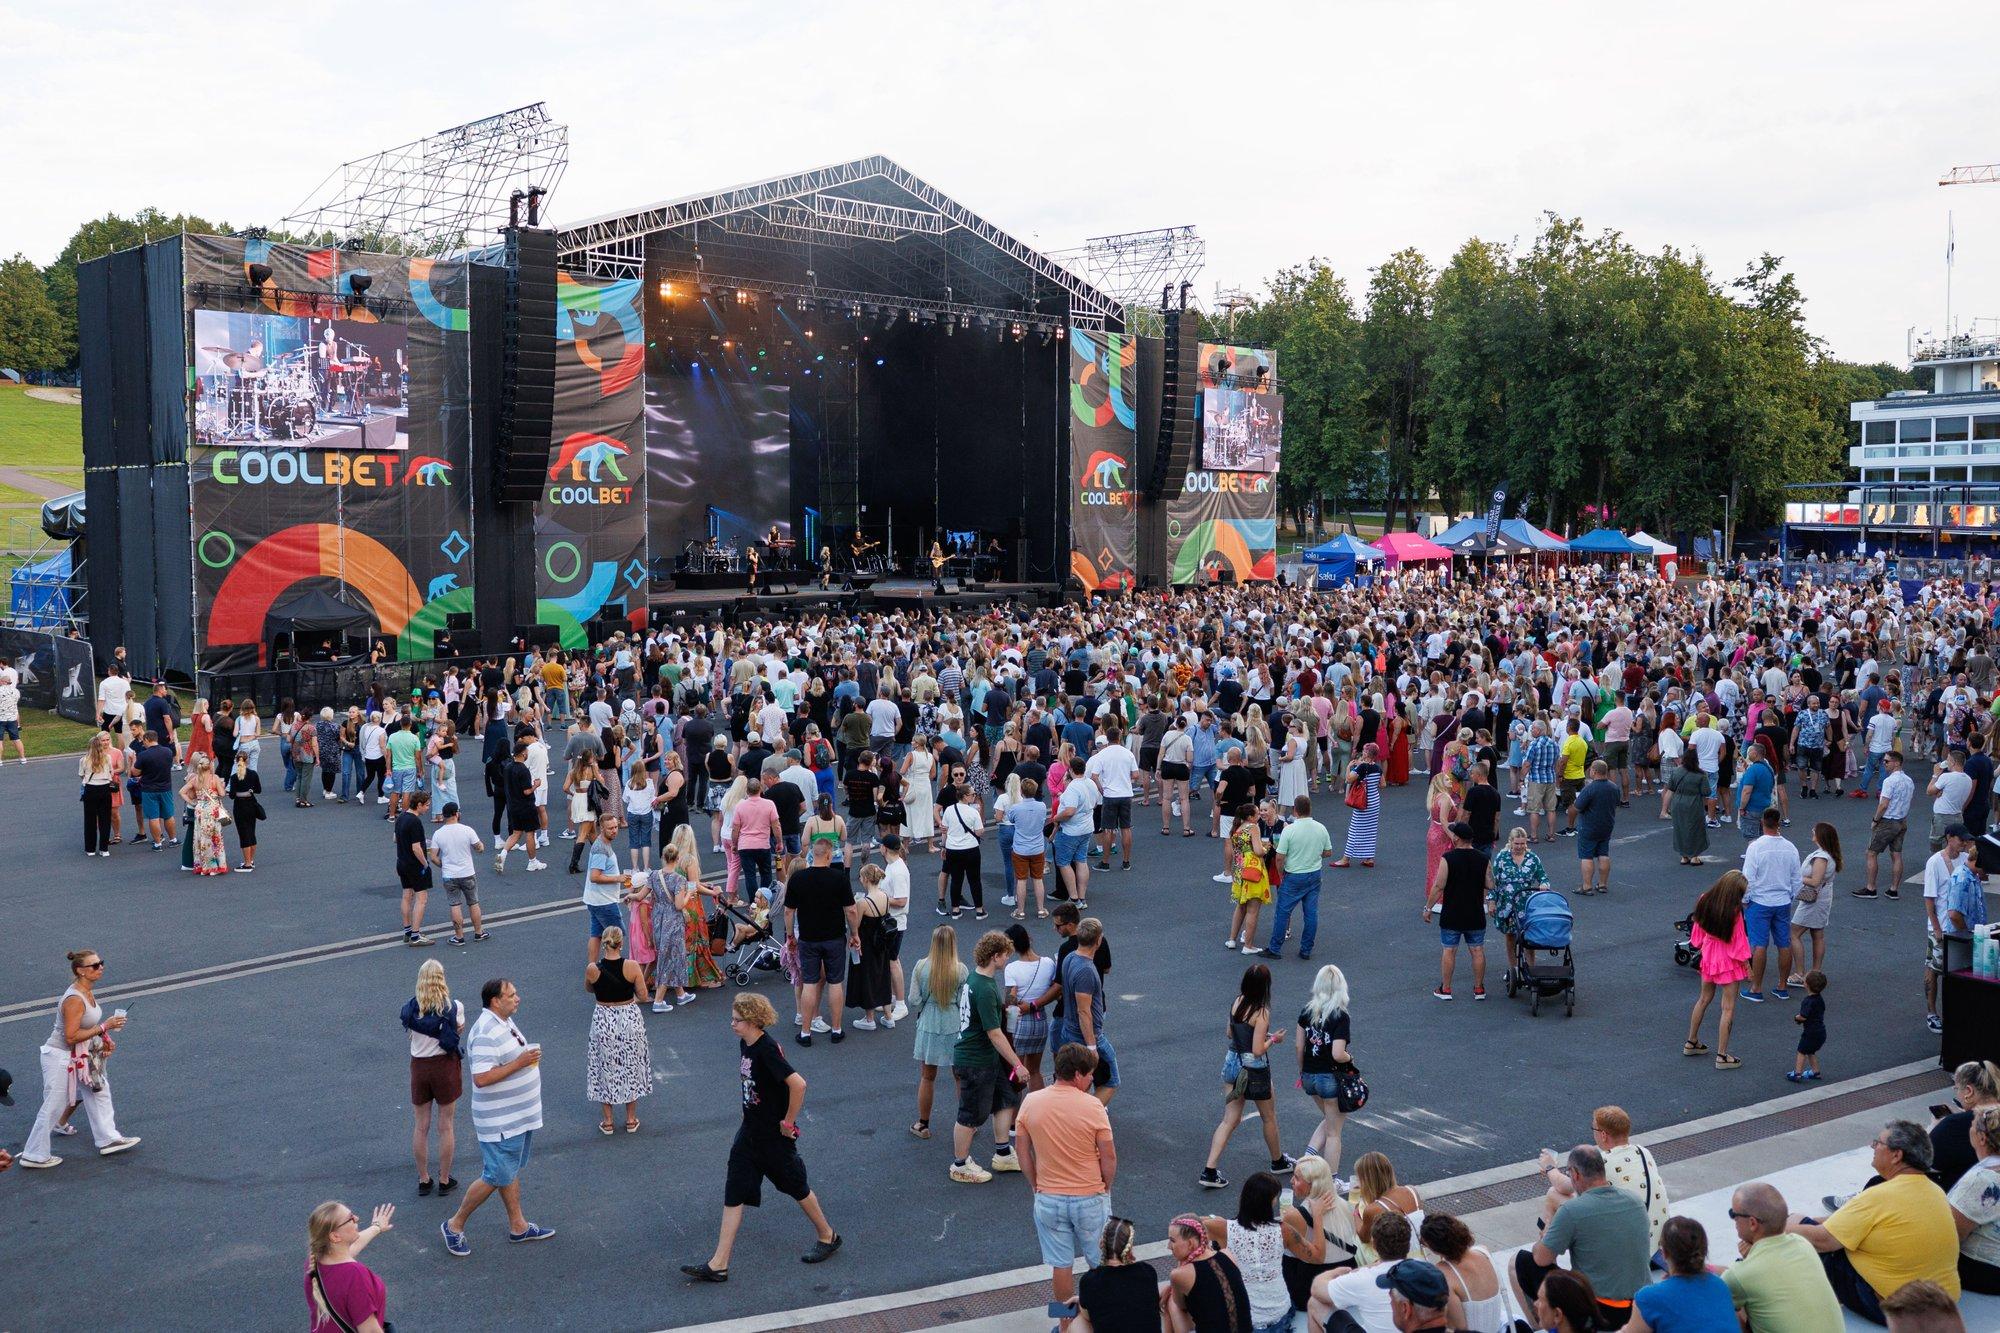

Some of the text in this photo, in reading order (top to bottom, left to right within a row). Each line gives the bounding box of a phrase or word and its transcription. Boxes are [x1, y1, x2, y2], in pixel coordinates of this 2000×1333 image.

[212, 451, 399, 486] COOLBET
[1182, 472, 1247, 493] OOLBET
[549, 487, 632, 504] COOLBET
[1081, 492, 1130, 505] COOLBET
[1318, 572, 1336, 580] saku
